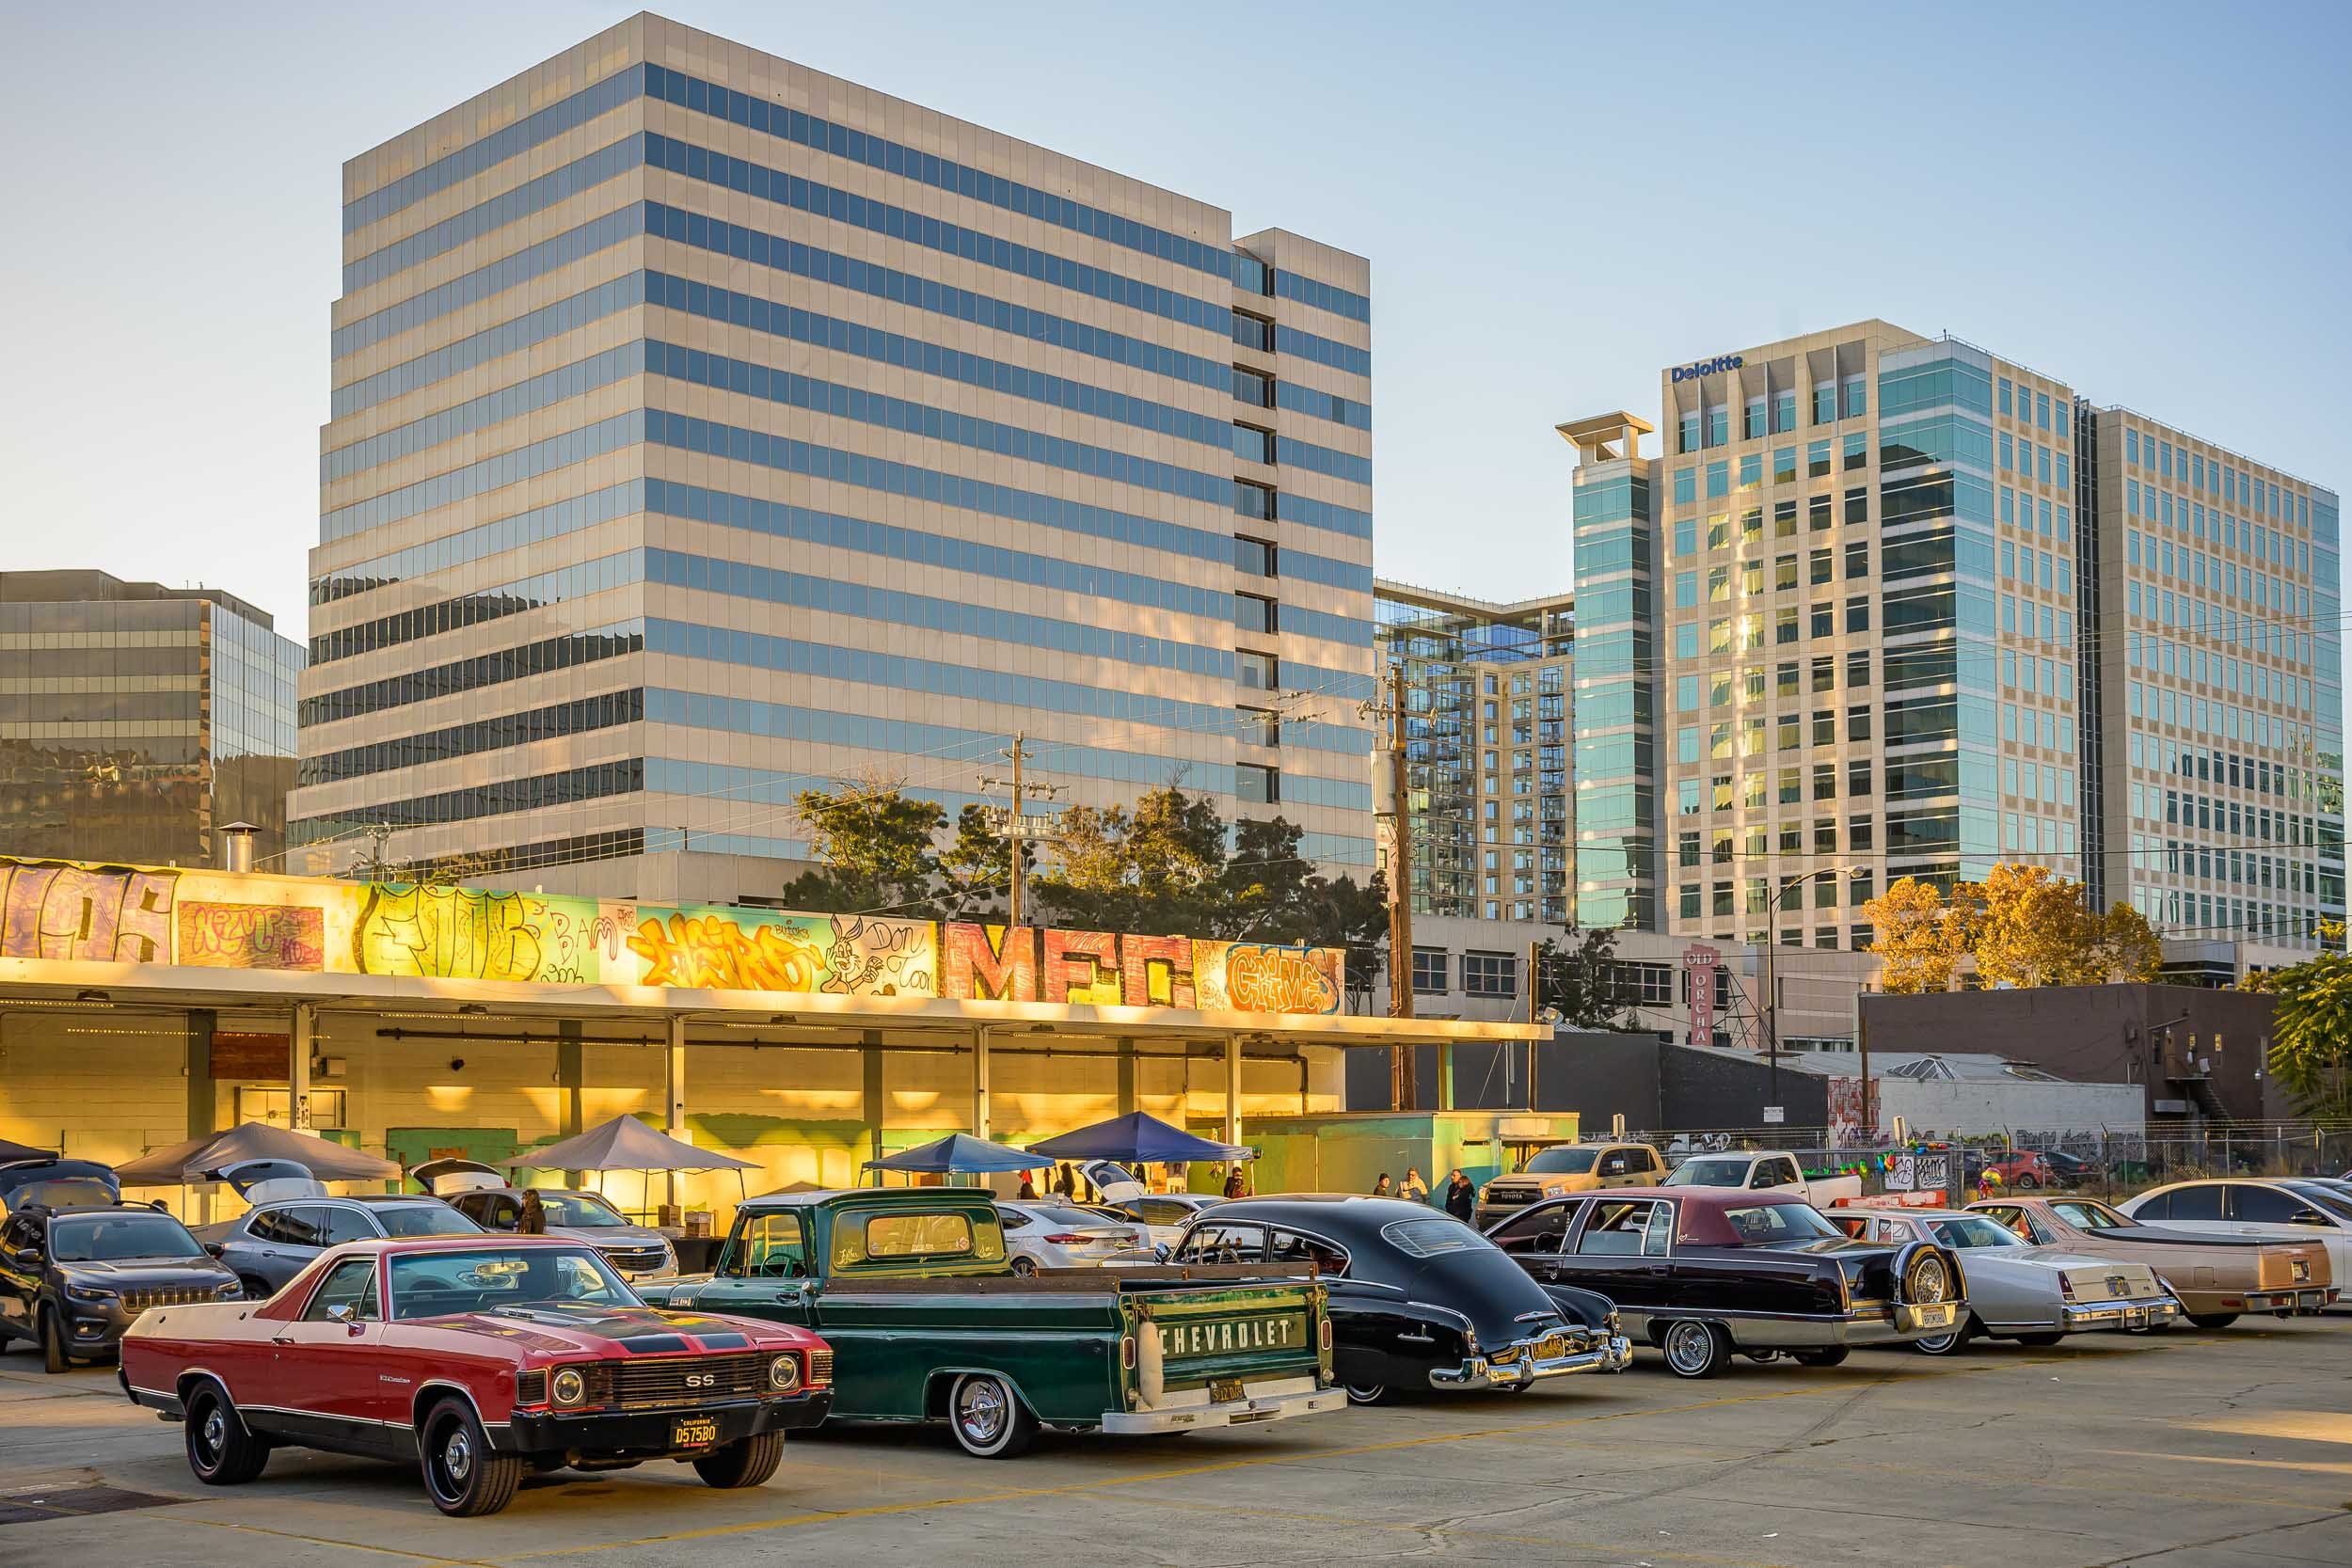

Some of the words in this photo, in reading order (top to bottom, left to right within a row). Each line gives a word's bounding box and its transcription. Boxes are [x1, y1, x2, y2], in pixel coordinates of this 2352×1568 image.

[1672, 356, 1743, 383] Deloitte
[550, 911, 618, 965] BAM
[866, 923, 925, 953] Don
[1687, 954, 1712, 965] OLD
[1158, 1319, 1290, 1355] CHEVROLET
[686, 1374, 715, 1387] SS
